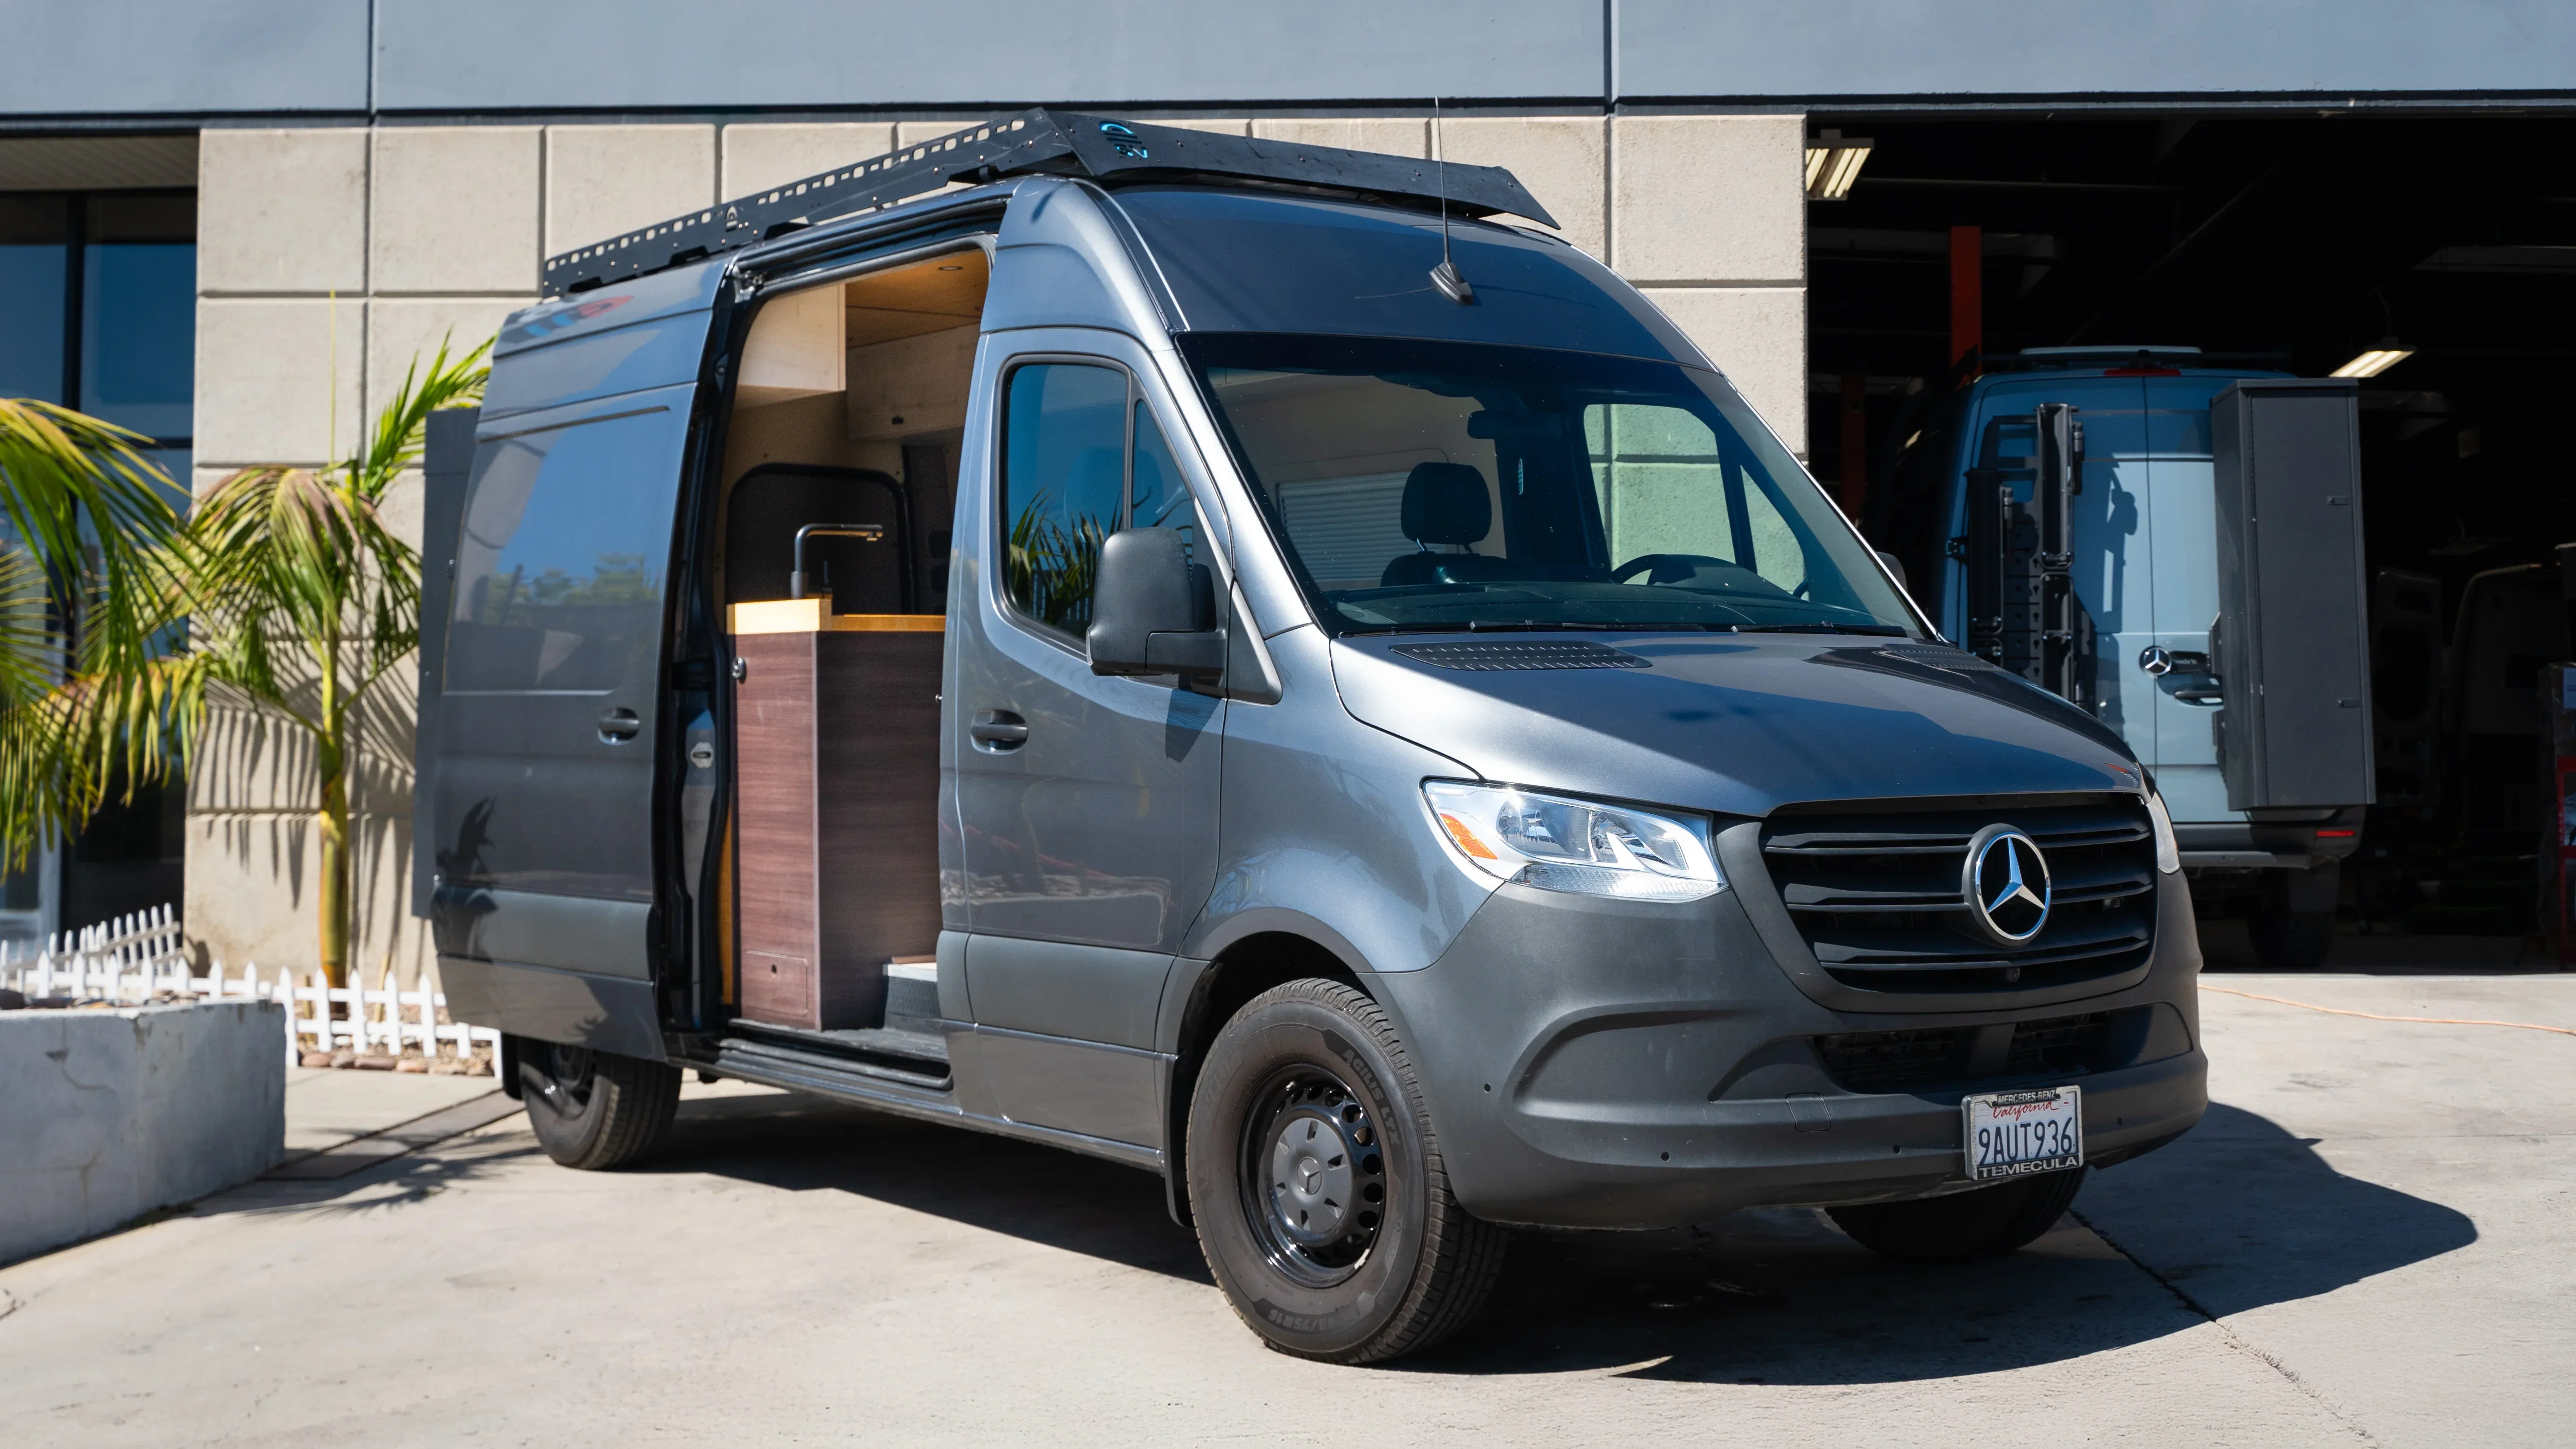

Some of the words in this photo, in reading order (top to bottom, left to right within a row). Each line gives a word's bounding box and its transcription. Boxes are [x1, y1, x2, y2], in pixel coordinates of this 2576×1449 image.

[1342, 1048, 1384, 1101] AGILIS
[1381, 1106, 1400, 1146] LTX
[1998, 1090, 2055, 1106] MERCEDES-BENZ
[1993, 1101, 2059, 1121] California
[1979, 1117, 2072, 1165] 9AUT936
[1980, 1156, 2078, 1178] TEMECULA
